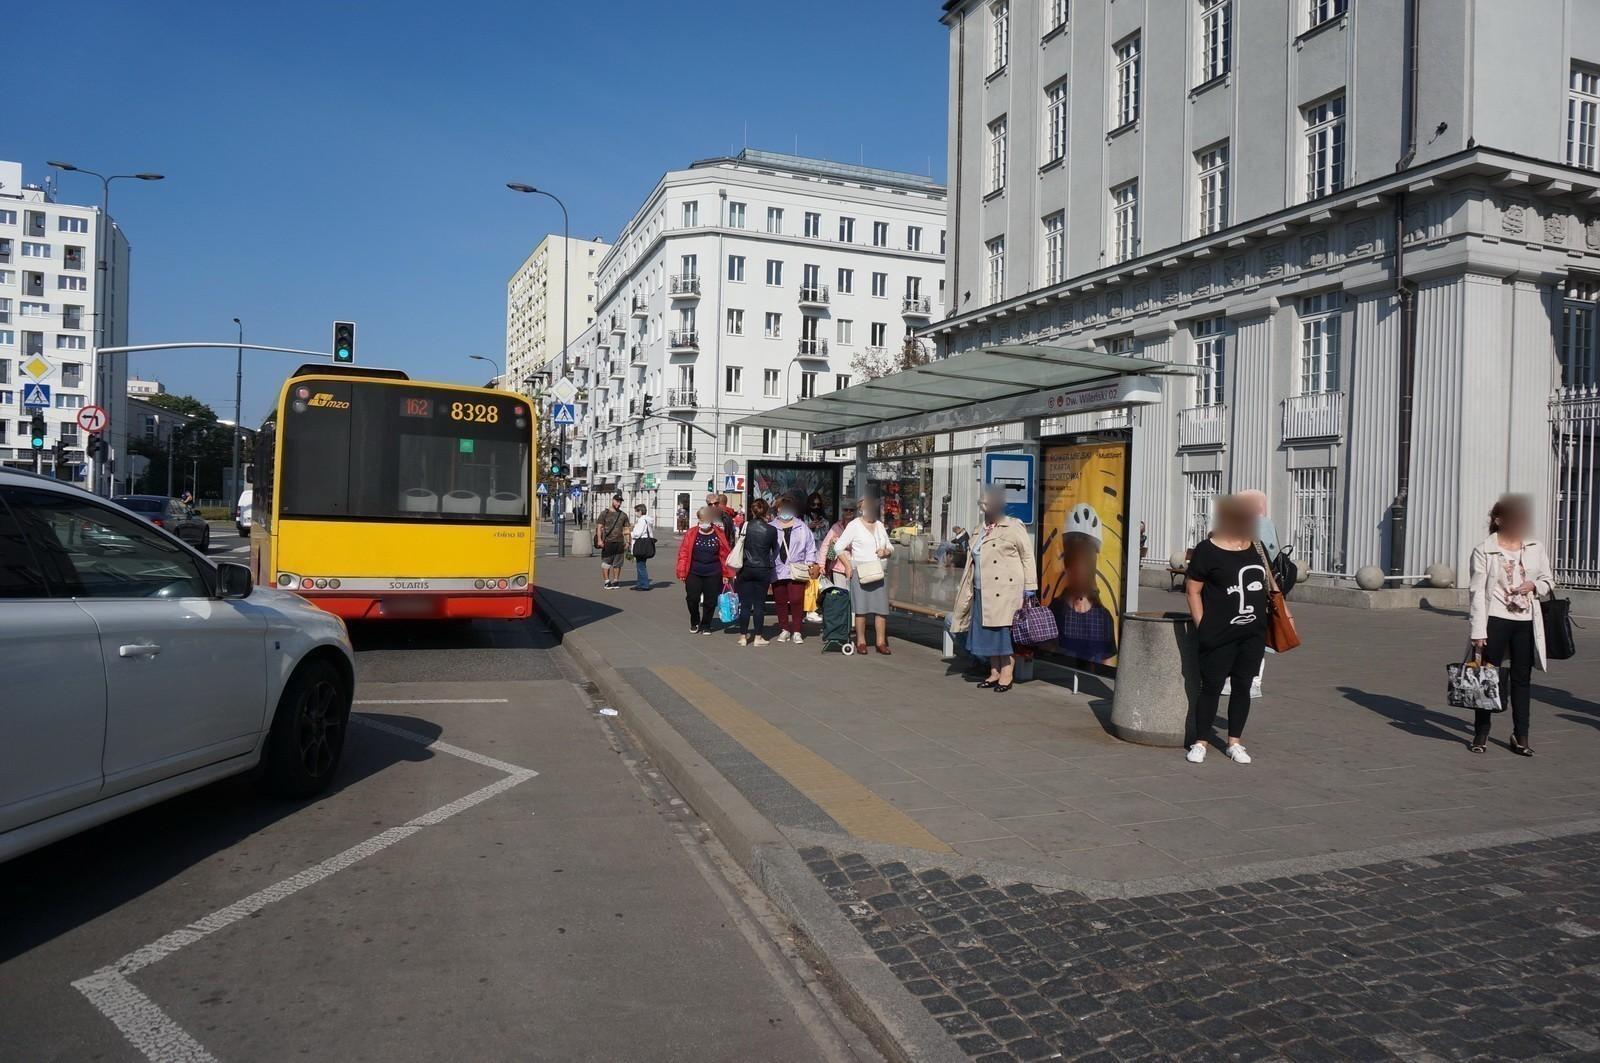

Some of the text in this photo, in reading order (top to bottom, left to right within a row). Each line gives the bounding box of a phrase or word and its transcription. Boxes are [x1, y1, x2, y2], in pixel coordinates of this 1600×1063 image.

[1109, 389, 1117, 399] 02
[407, 399, 428, 416] 162
[451, 403, 498, 423] 8328
